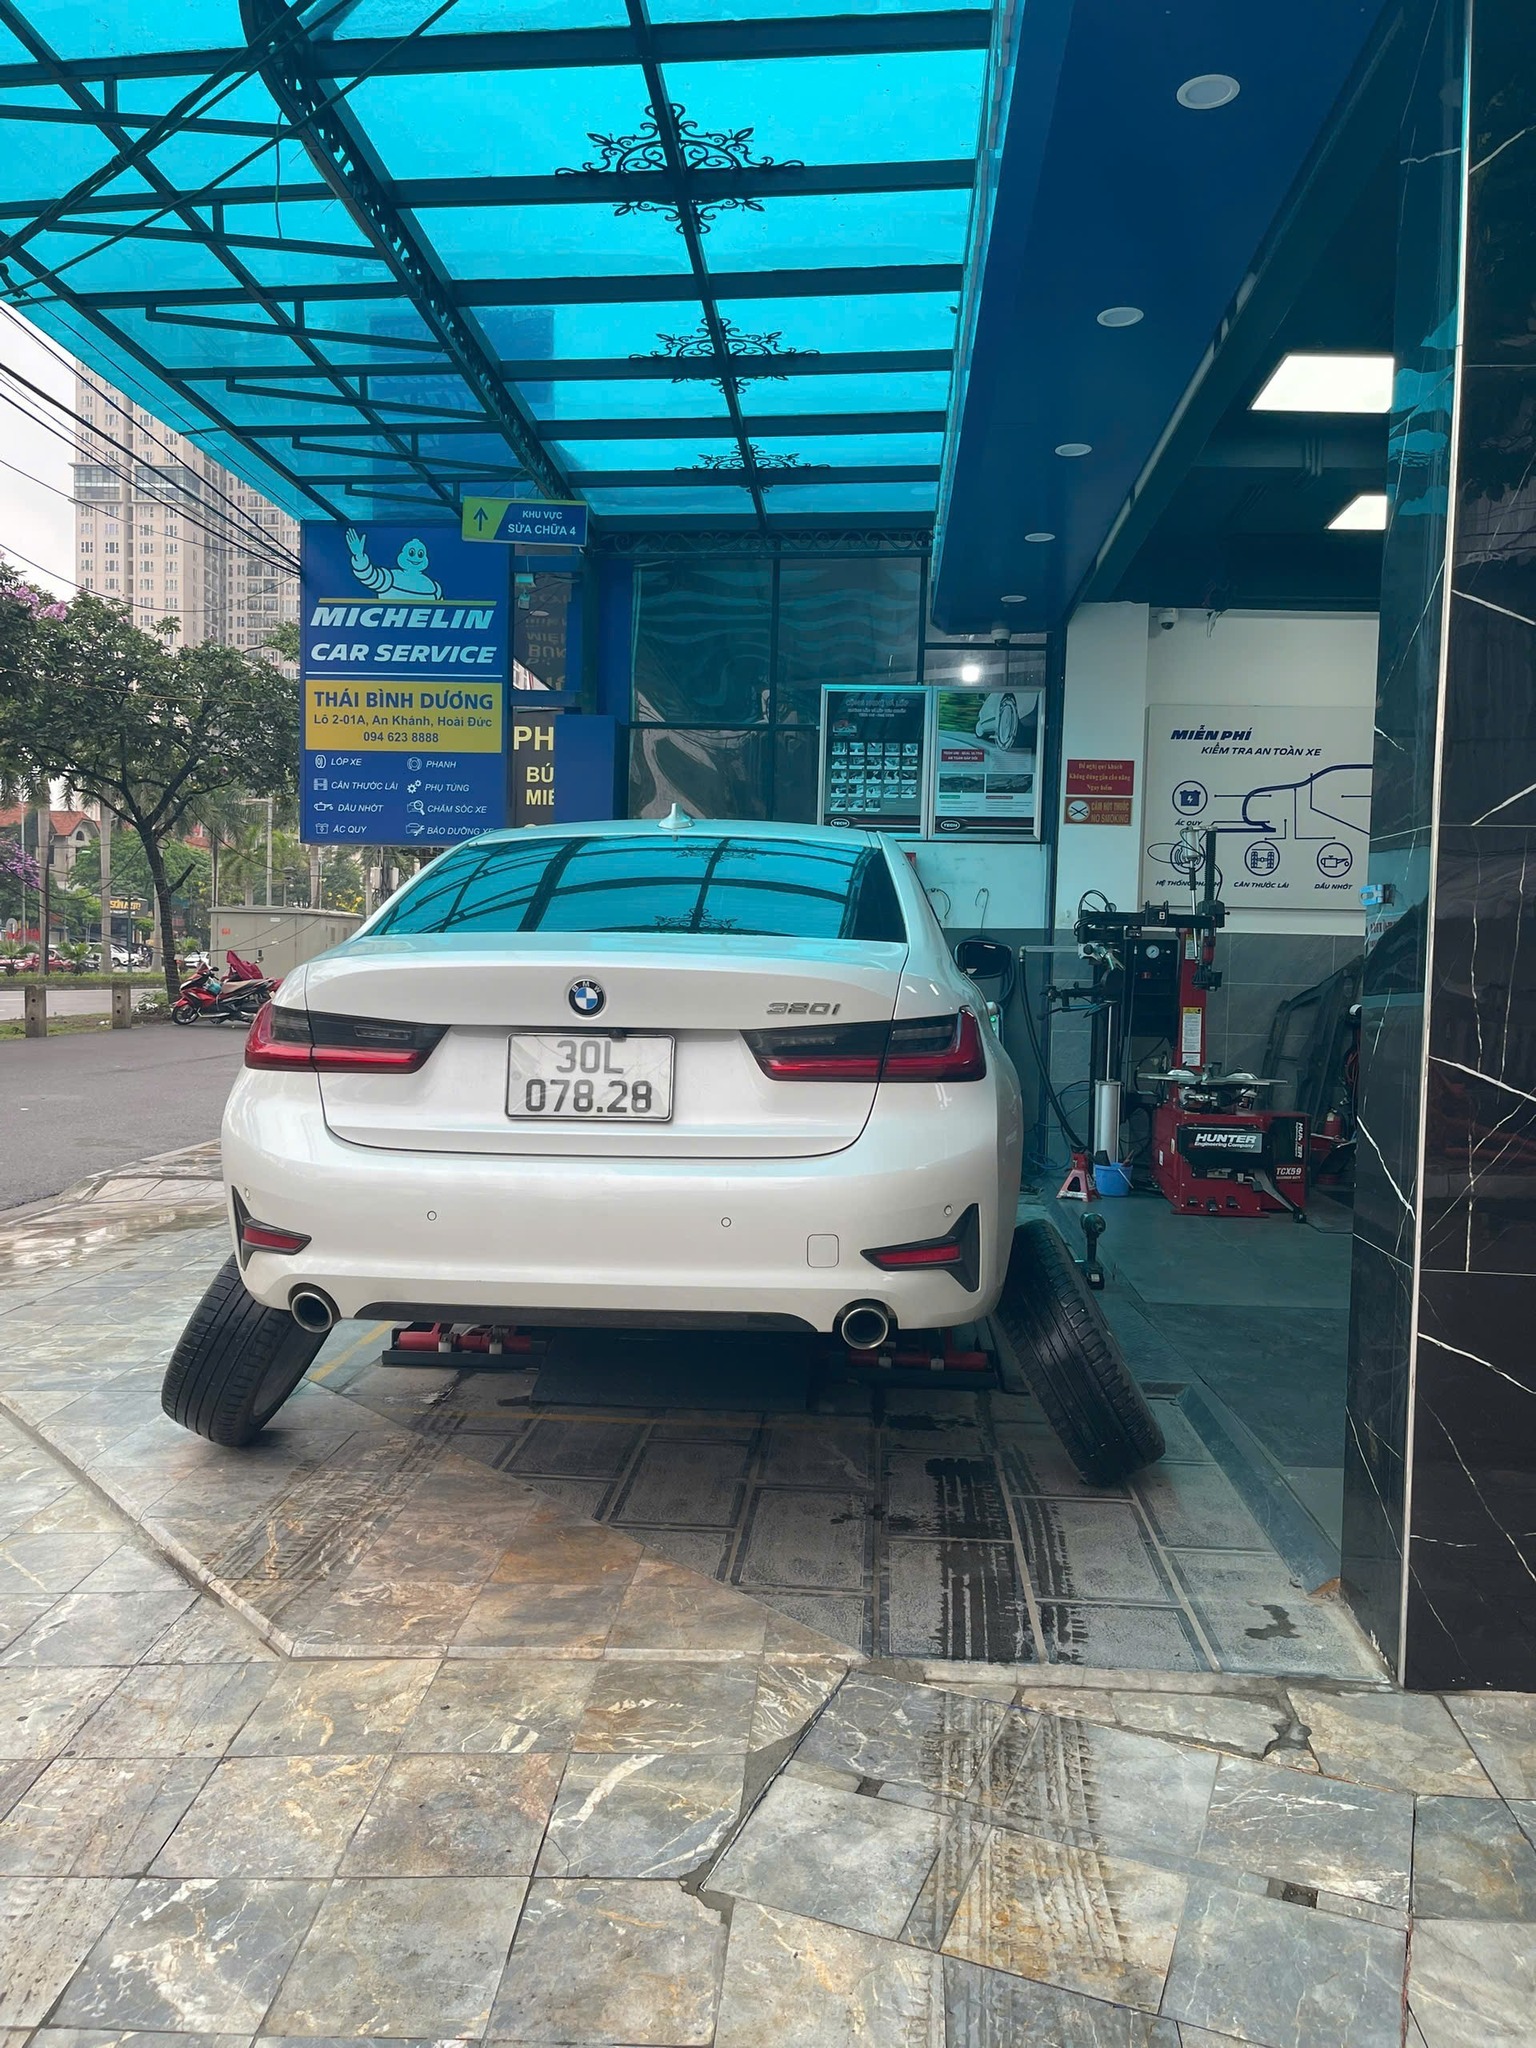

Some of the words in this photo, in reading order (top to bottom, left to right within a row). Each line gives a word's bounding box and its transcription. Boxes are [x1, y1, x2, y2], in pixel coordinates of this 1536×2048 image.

[522, 510, 542, 519] KHU
[543, 511, 563, 521] VỰC
[507, 522, 532, 534] SỬA
[534, 523, 567, 536] CHỮA
[569, 526, 577, 536] 4
[310, 606, 495, 630] MICHELIN
[310, 643, 370, 662] CAR
[374, 644, 498, 664] SERVICE
[314, 688, 359, 708] THÁI
[366, 688, 414, 709] BÌNH
[420, 689, 493, 710] DƯƠNG
[314, 714, 329, 725] Lô
[332, 714, 369, 727] 2-01A,
[372, 715, 389, 726] An
[392, 715, 434, 728] Khánh,
[437, 716, 465, 727] Hoài
[467, 716, 493, 728] Đức
[363, 731, 384, 742] 094
[387, 732, 408, 743] 623
[411, 732, 439, 743] 8888
[1171, 725, 1220, 741] MIỄN
[1220, 727, 1253, 741] PHÍ
[1201, 742, 1229, 755] KIỂM
[1231, 747, 1253, 755] TRA
[1254, 747, 1271, 756] AN
[1274, 745, 1304, 756] TOÀN
[1305, 748, 1322, 757] XE
[350, 758, 362, 766] XE
[426, 760, 457, 769] PHANH
[425, 783, 444, 793] PHỤ
[475, 806, 488, 814] XE
[1090, 813, 1101, 823] NO
[1101, 813, 1129, 823] SMOKING
[347, 825, 368, 834] QUY
[571, 981, 602, 993] BMW
[766, 1002, 841, 1016] 320i
[556, 1040, 624, 1075] 30L
[526, 1078, 652, 1113] 078.28
[1196, 1133, 1257, 1144] HUNTER
[1194, 1141, 1227, 1149] Engineering
[1276, 1167, 1302, 1176] TCX59
